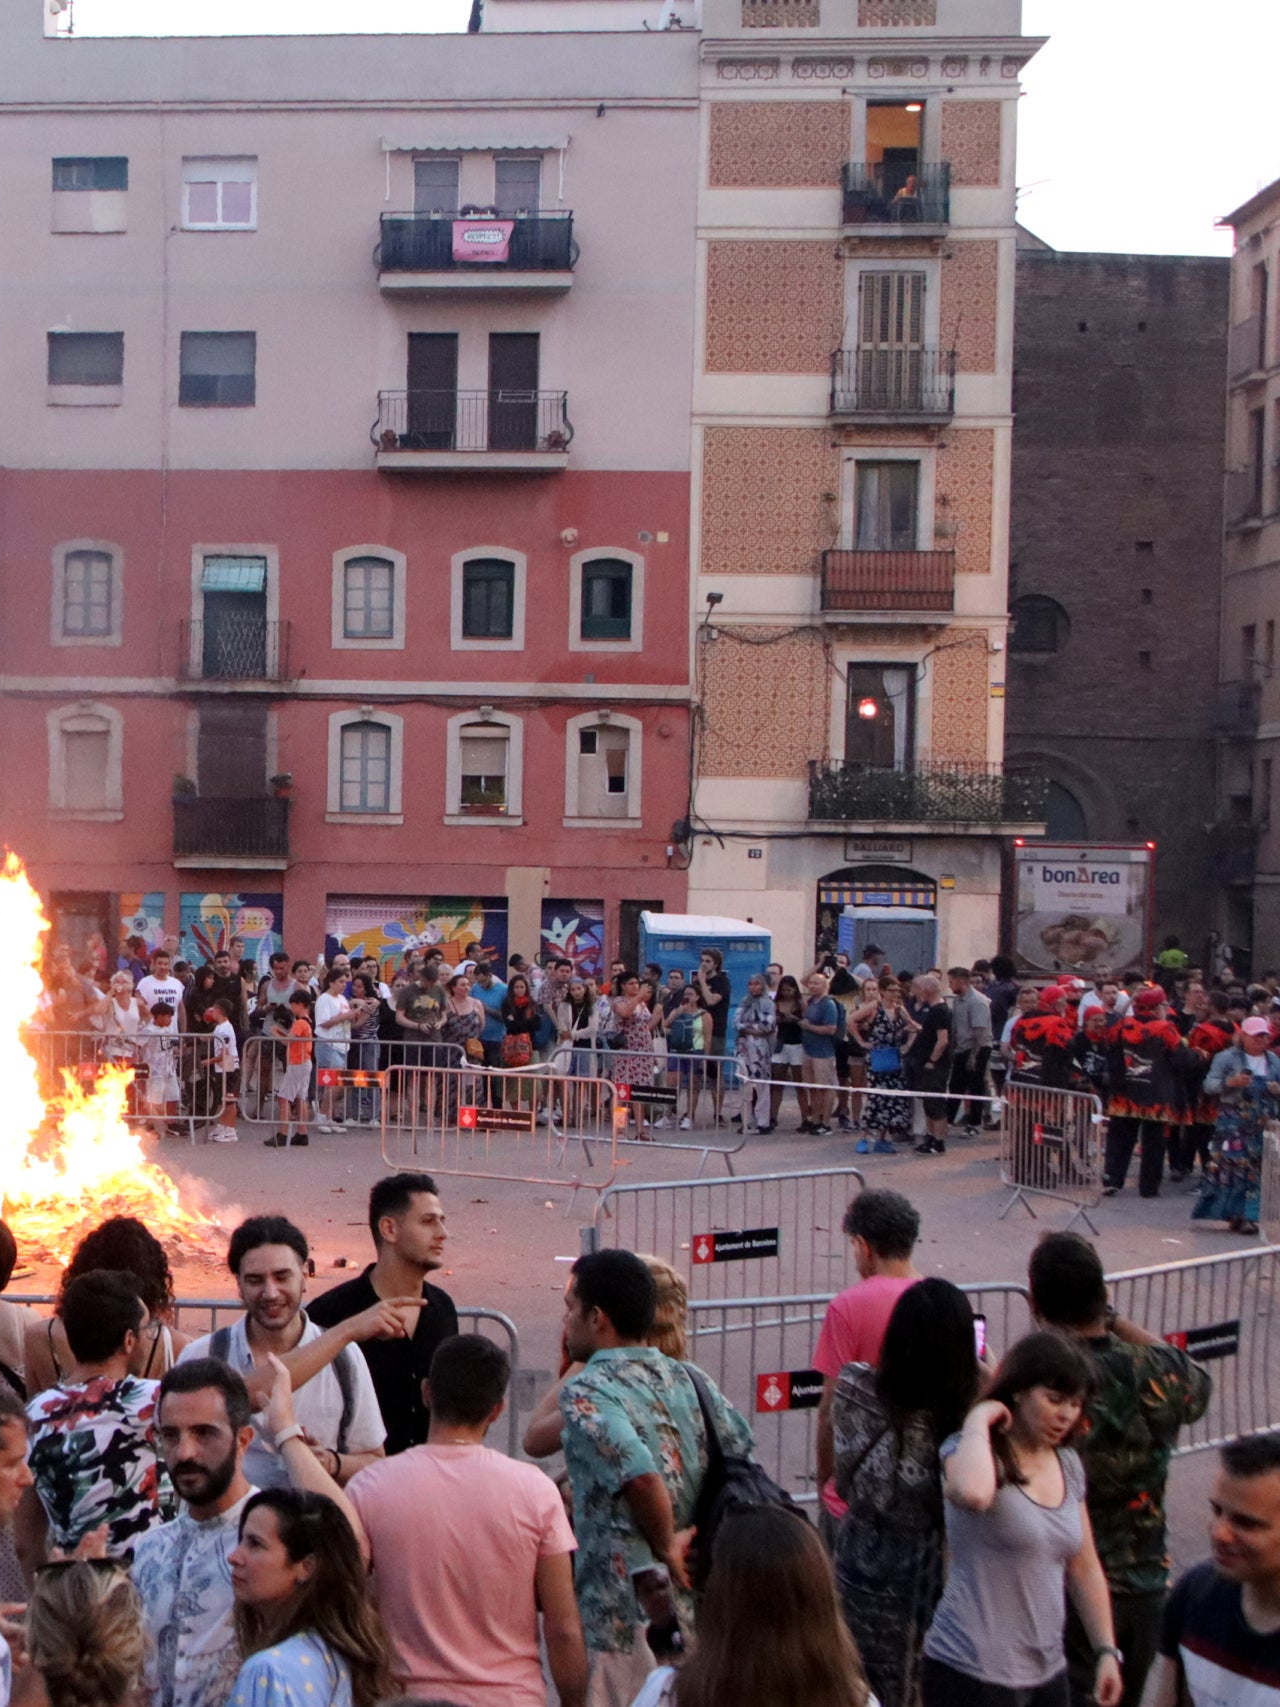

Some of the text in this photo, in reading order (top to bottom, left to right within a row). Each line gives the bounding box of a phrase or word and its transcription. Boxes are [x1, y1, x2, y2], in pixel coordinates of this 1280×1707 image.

[715, 1241, 743, 1252] Ajuntament
[752, 1238, 776, 1248] Barcelona
[791, 1384, 825, 1398] Ajuntam
